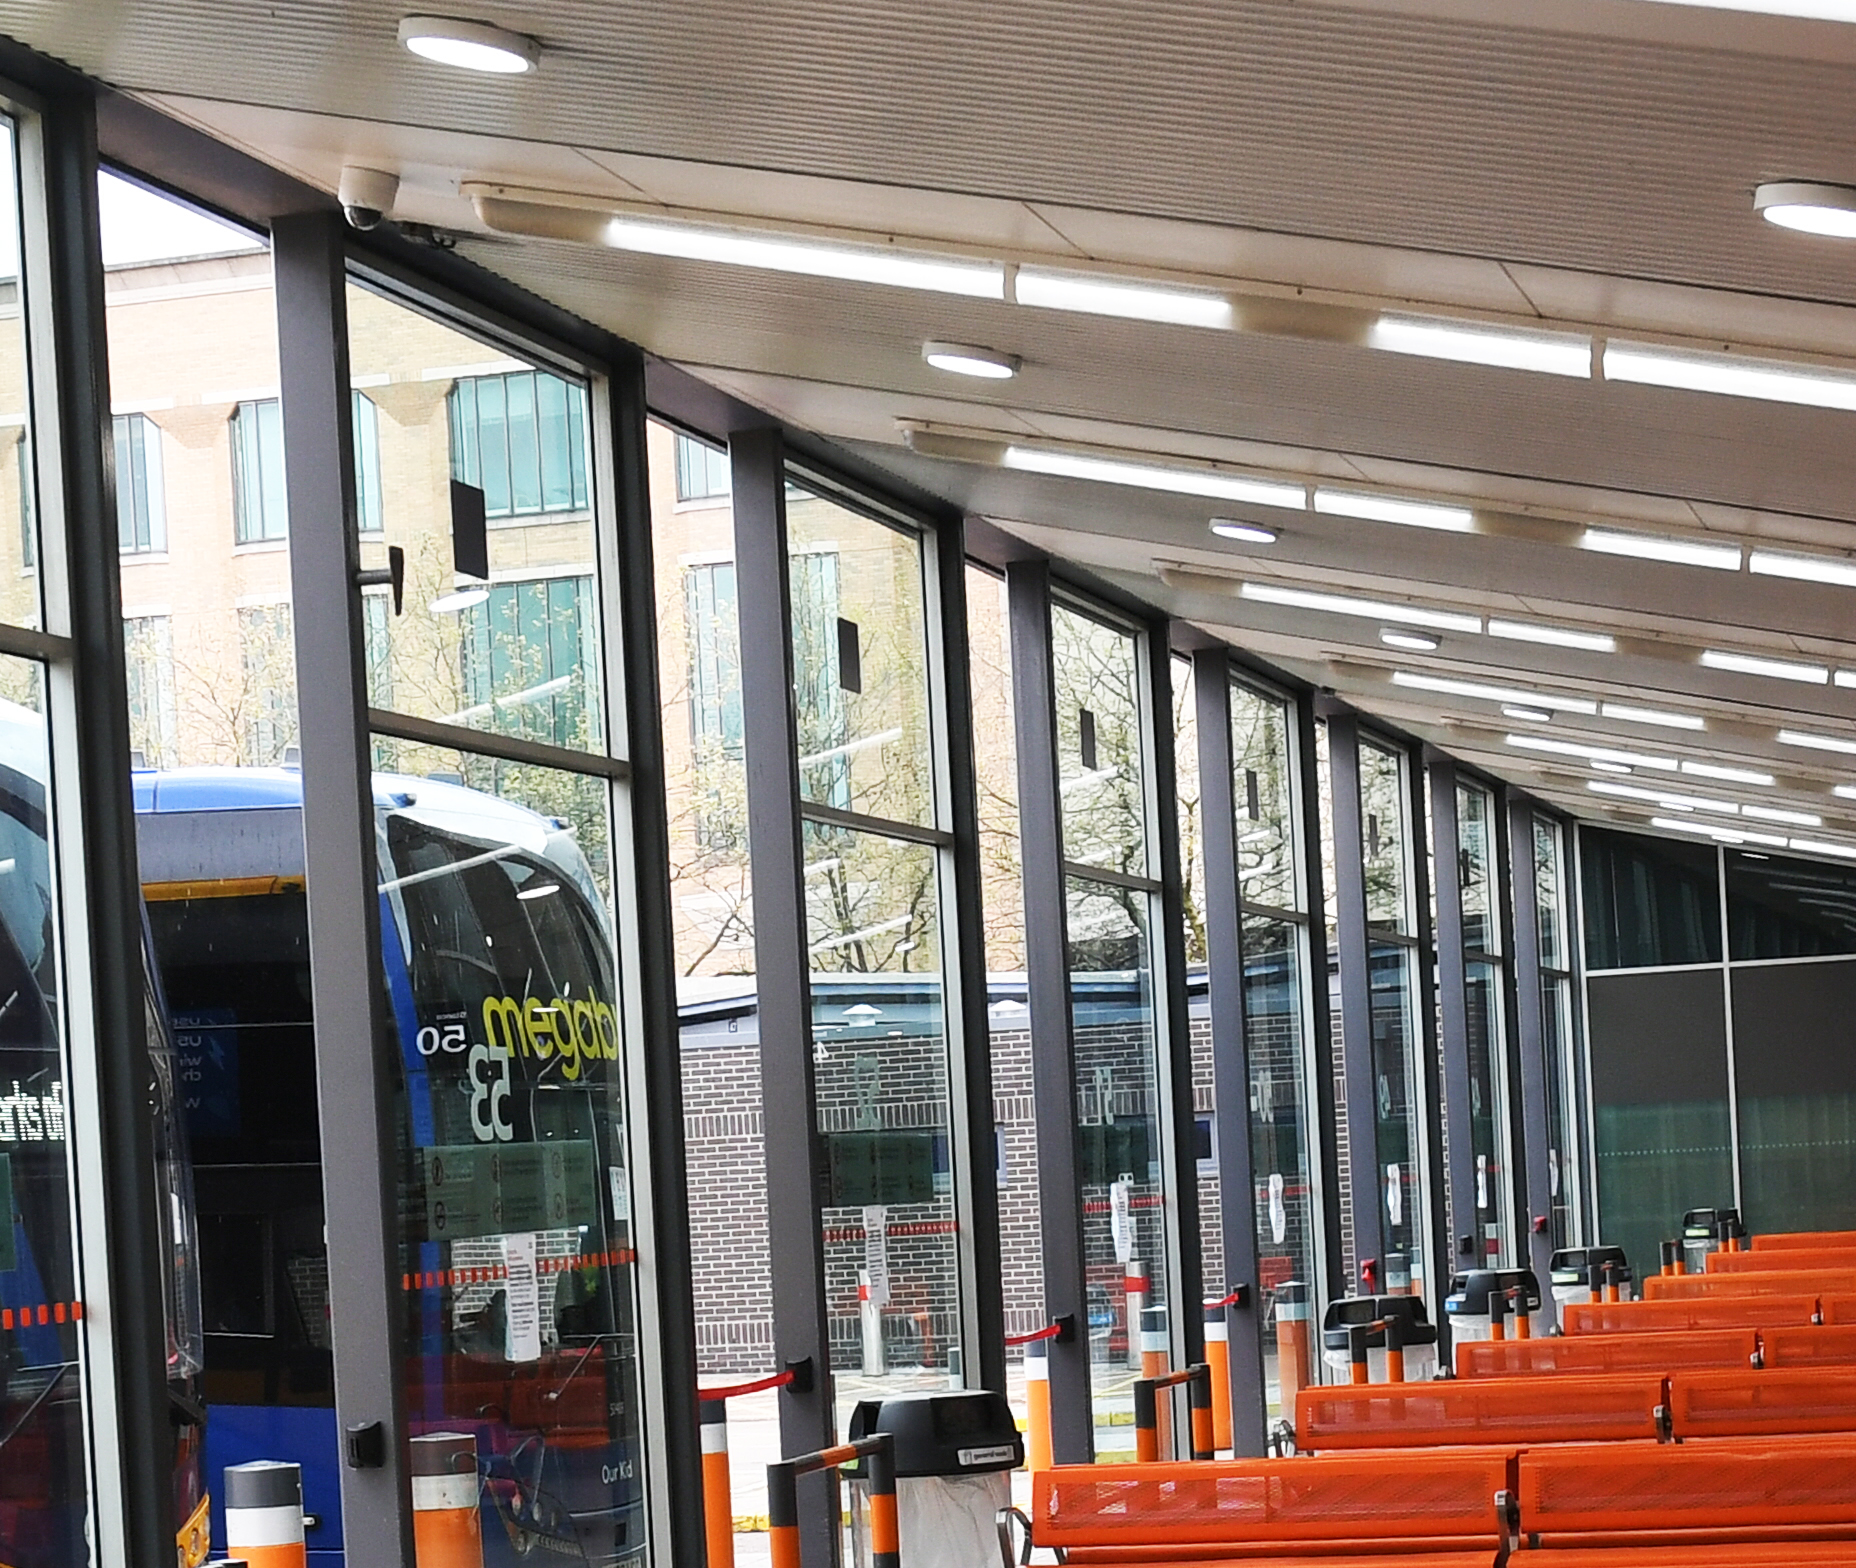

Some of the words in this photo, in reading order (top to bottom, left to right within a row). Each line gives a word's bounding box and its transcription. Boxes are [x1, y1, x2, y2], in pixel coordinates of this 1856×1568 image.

[482, 985, 619, 1081] megab
[601, 1464, 619, 1484] Our
[618, 1459, 634, 1480] Kid
